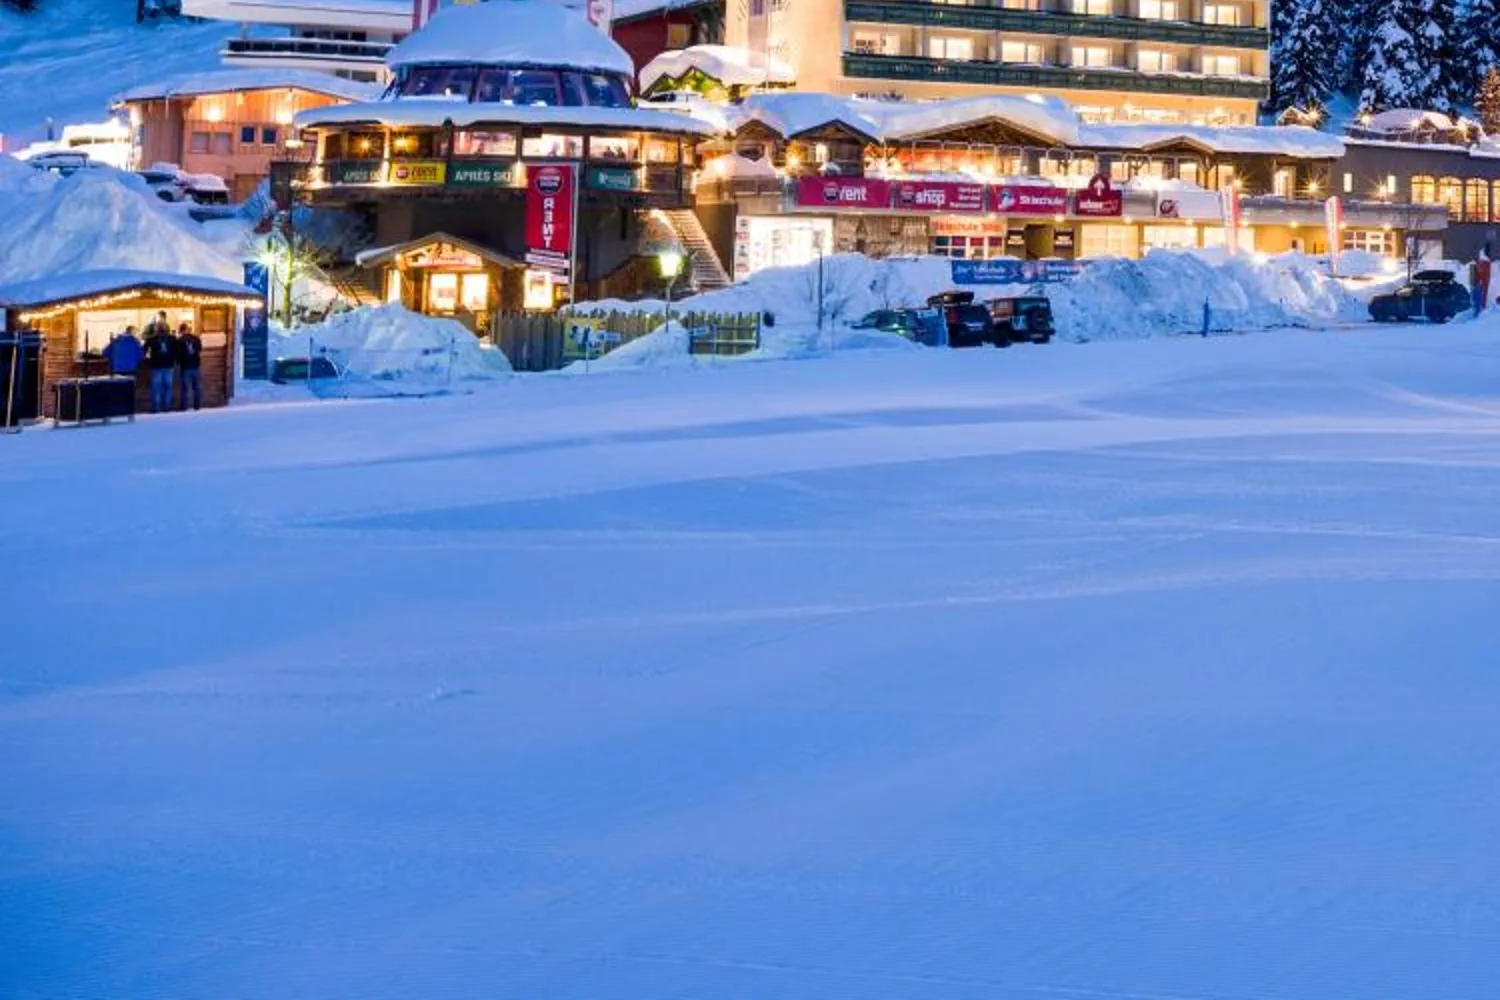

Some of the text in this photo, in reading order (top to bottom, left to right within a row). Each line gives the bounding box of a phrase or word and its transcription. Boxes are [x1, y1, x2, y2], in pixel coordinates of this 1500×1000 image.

[493, 170, 512, 183] SKI
[838, 185, 867, 201] rent
[915, 188, 946, 208] shop
